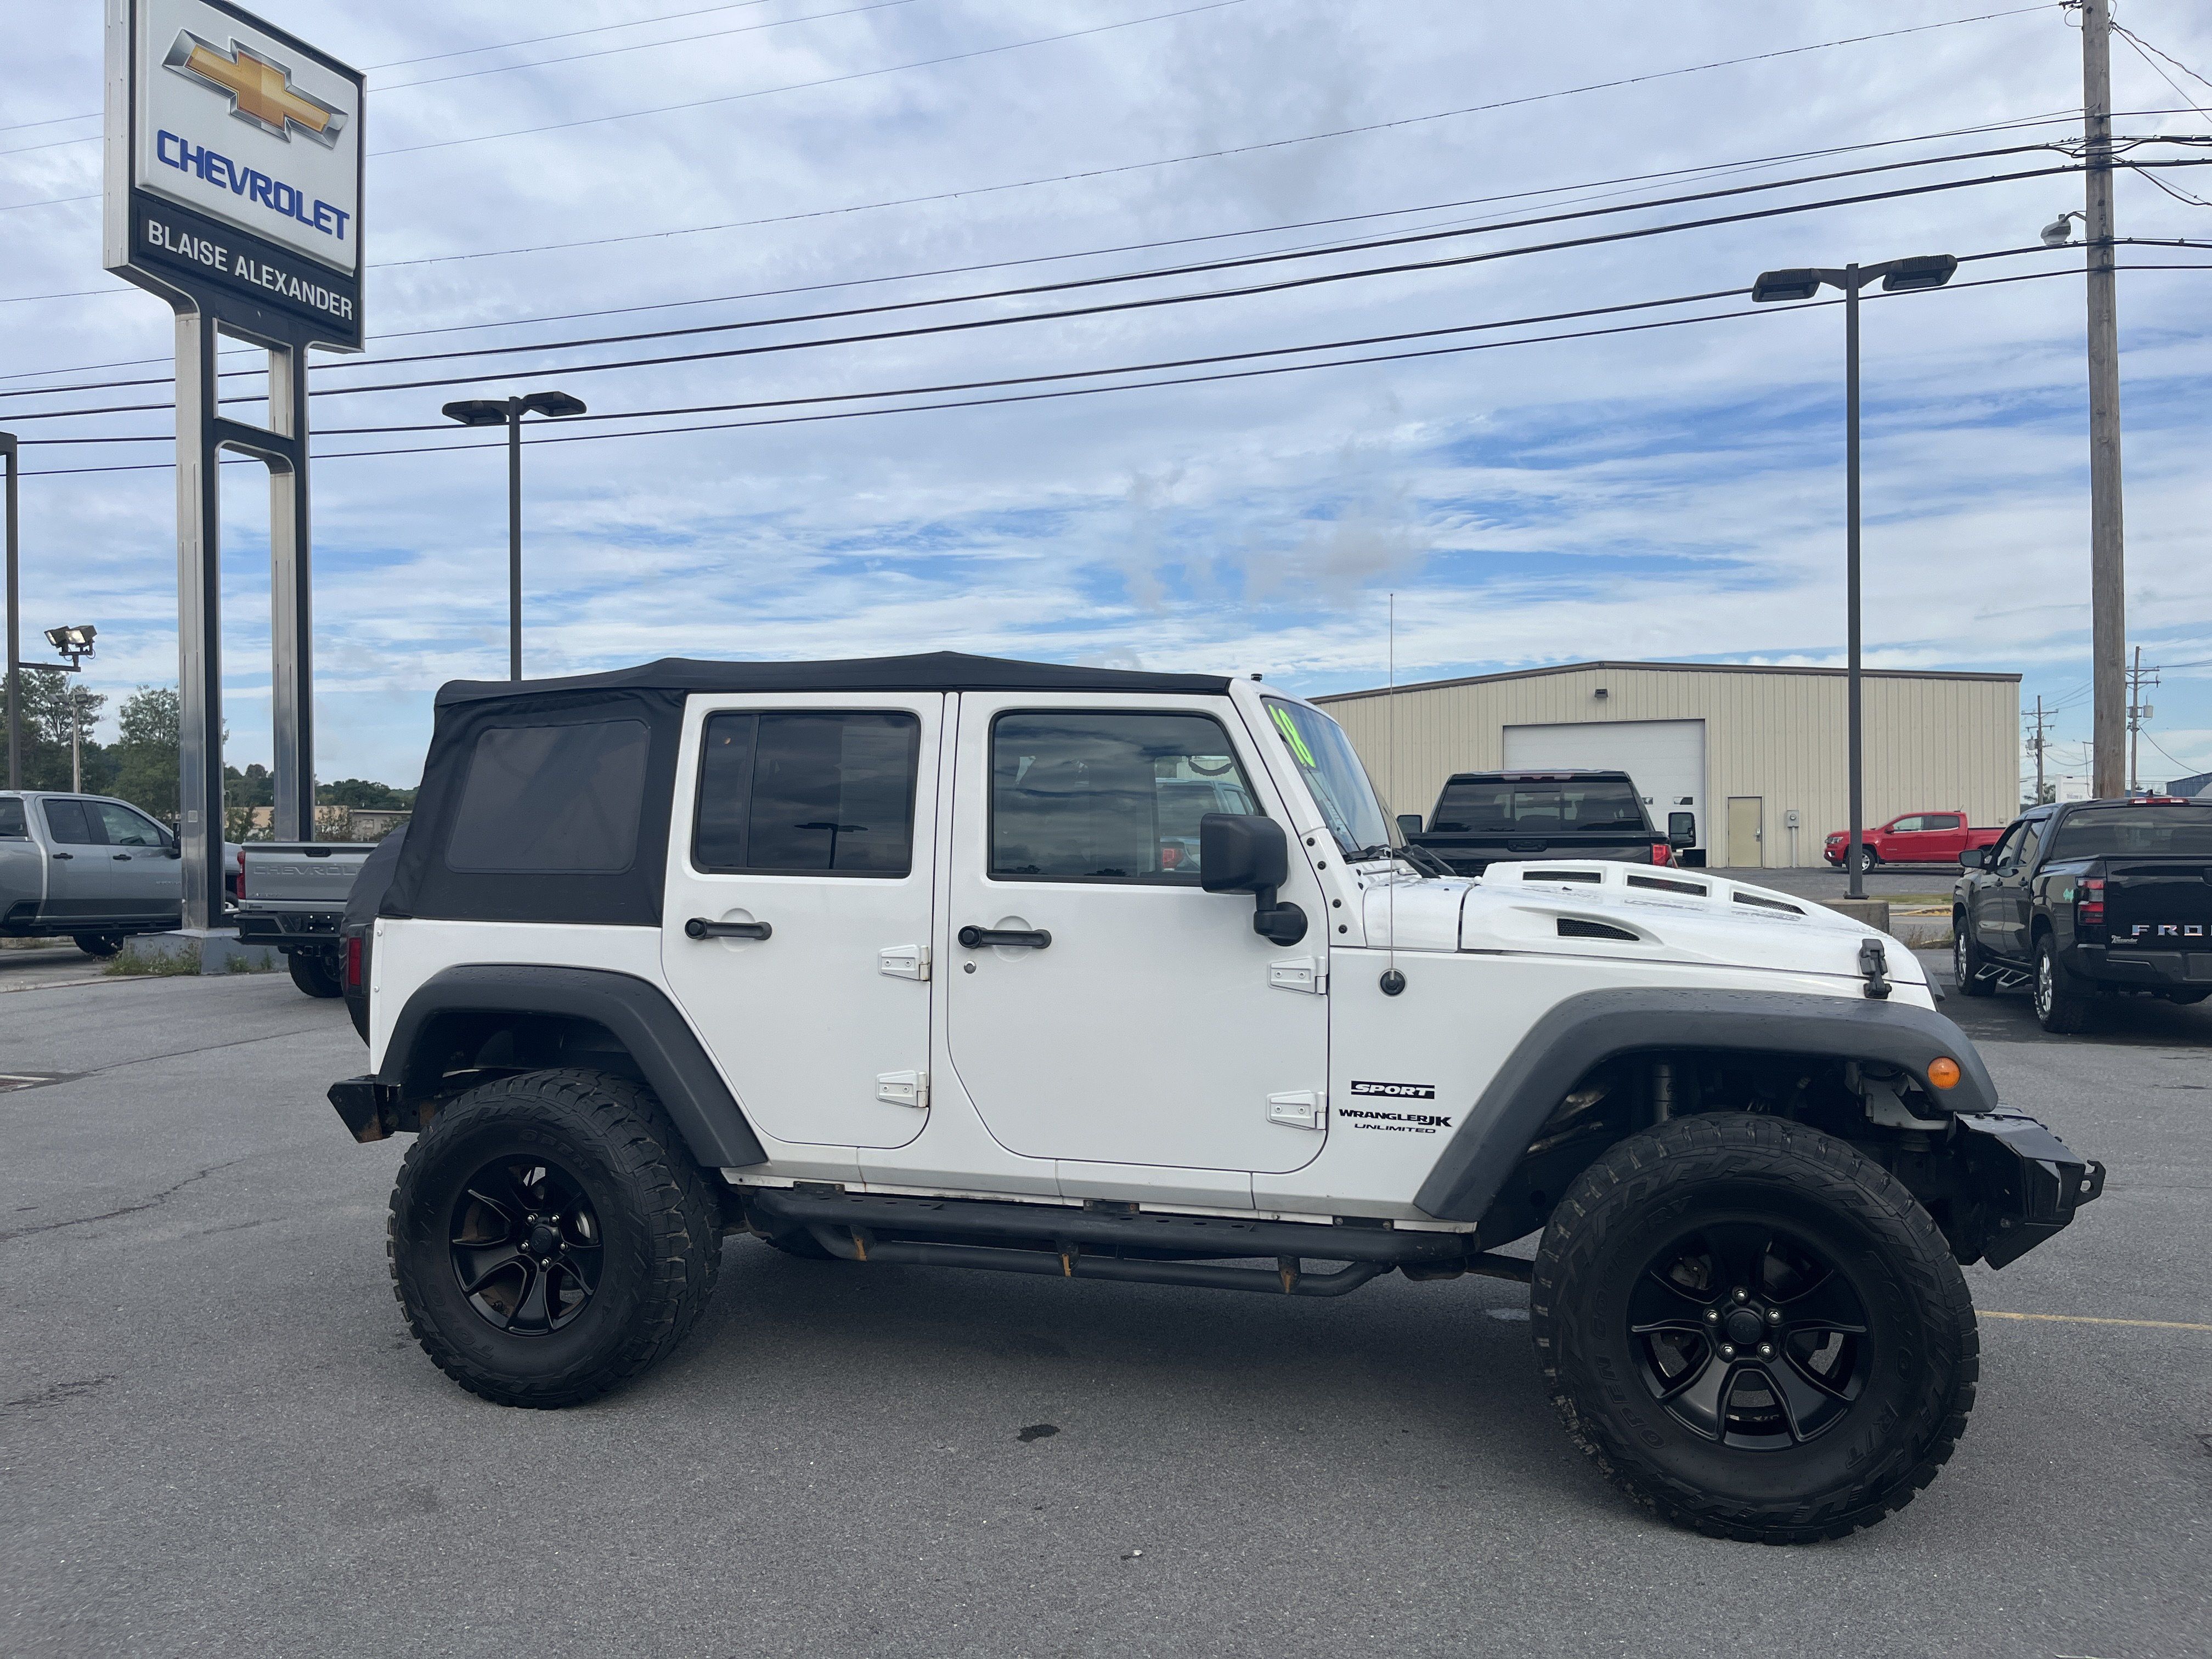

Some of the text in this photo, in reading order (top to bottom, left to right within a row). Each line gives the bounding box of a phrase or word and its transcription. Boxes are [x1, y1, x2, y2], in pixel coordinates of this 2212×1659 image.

[156, 129, 349, 240] CHEVROLET
[148, 219, 353, 321] BLAISE ALEXANDER
[1268, 704, 1316, 768] 18
[253, 866, 362, 876] CHEVROL
[2131, 924, 2212, 936] FRO
[1355, 1084, 1434, 1097] SPORT
[1354, 1123, 1436, 1133] UNLIMITED
[1595, 1354, 1667, 1449] OPEN
